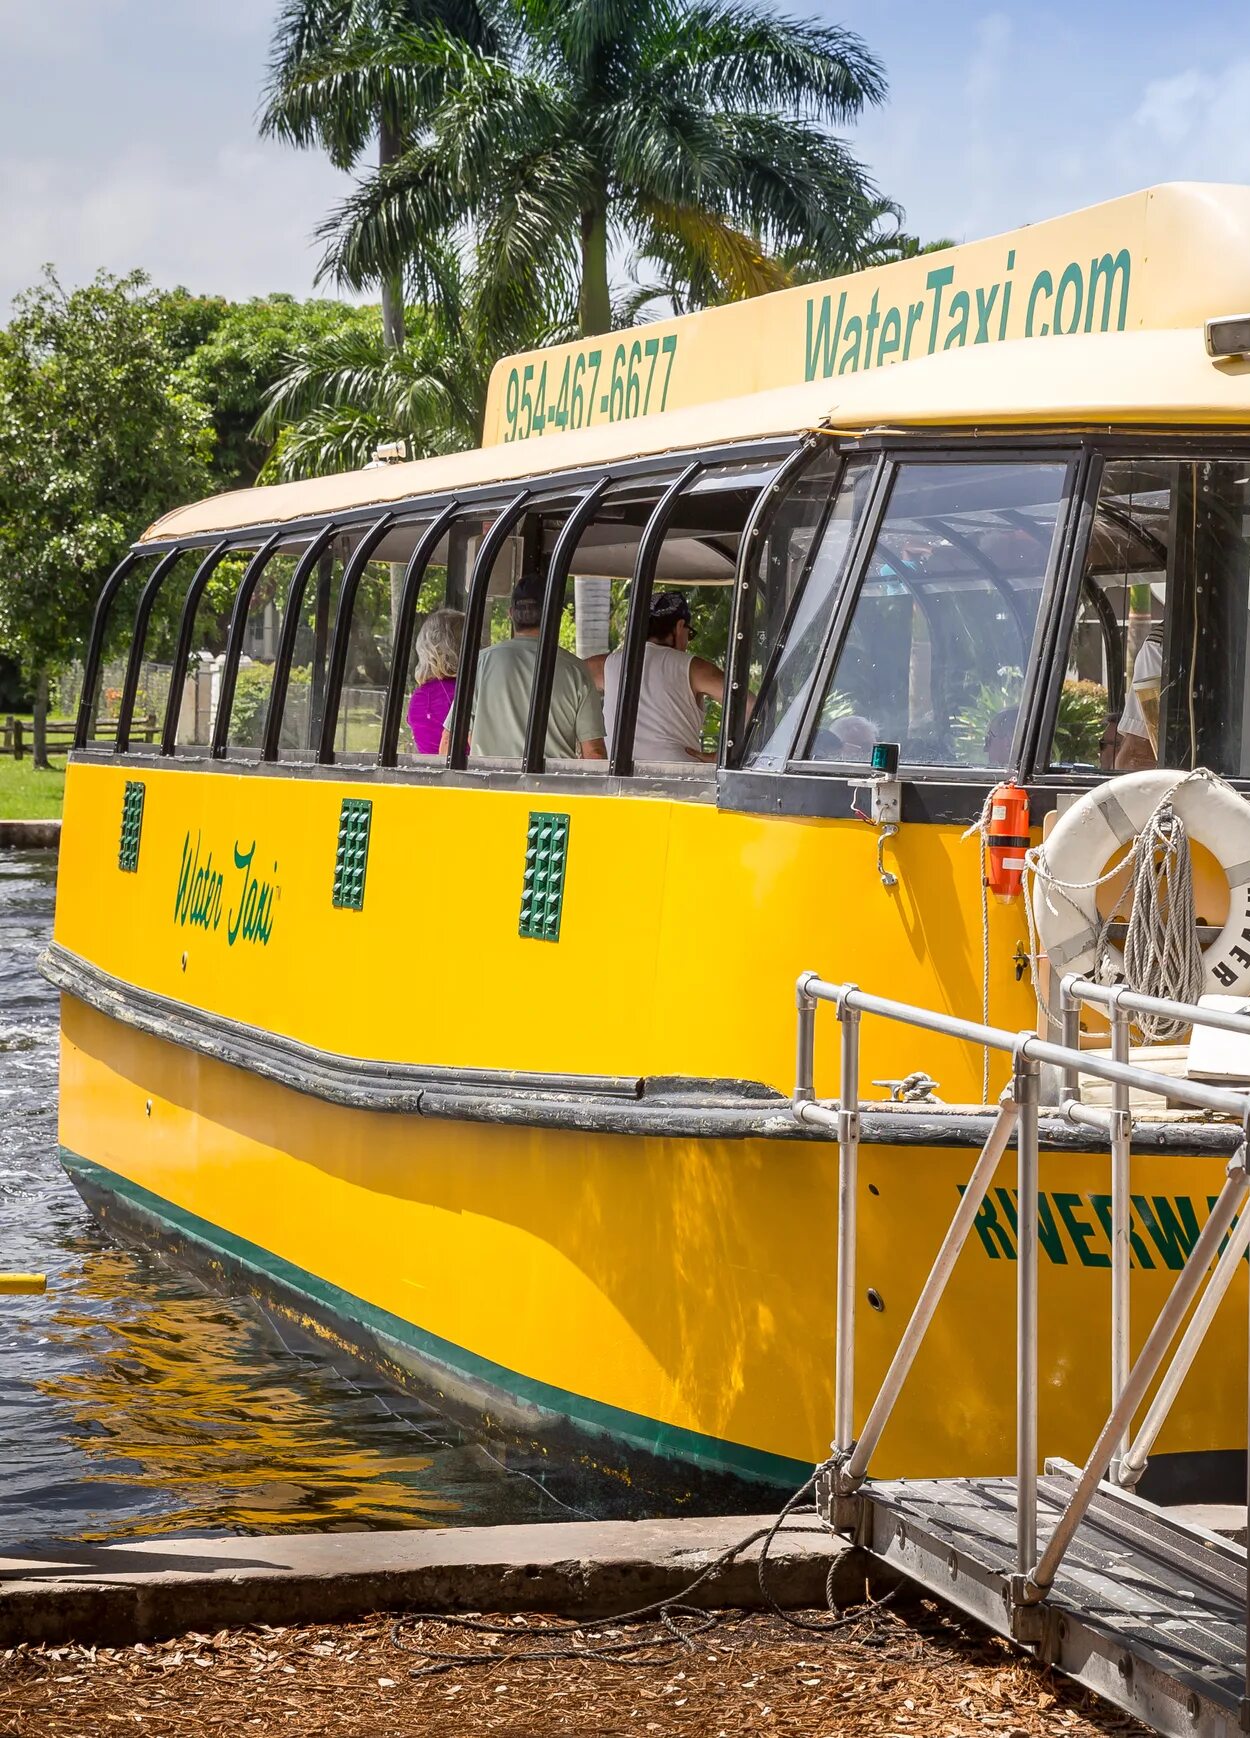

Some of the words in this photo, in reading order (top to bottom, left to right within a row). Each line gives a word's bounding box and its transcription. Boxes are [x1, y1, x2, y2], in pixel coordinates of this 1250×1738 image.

[804, 248, 1131, 382] WaterTaxicom
[504, 334, 678, 443] 954-467-6677
[174, 828, 223, 931] Water
[228, 840, 277, 946] Taxi
